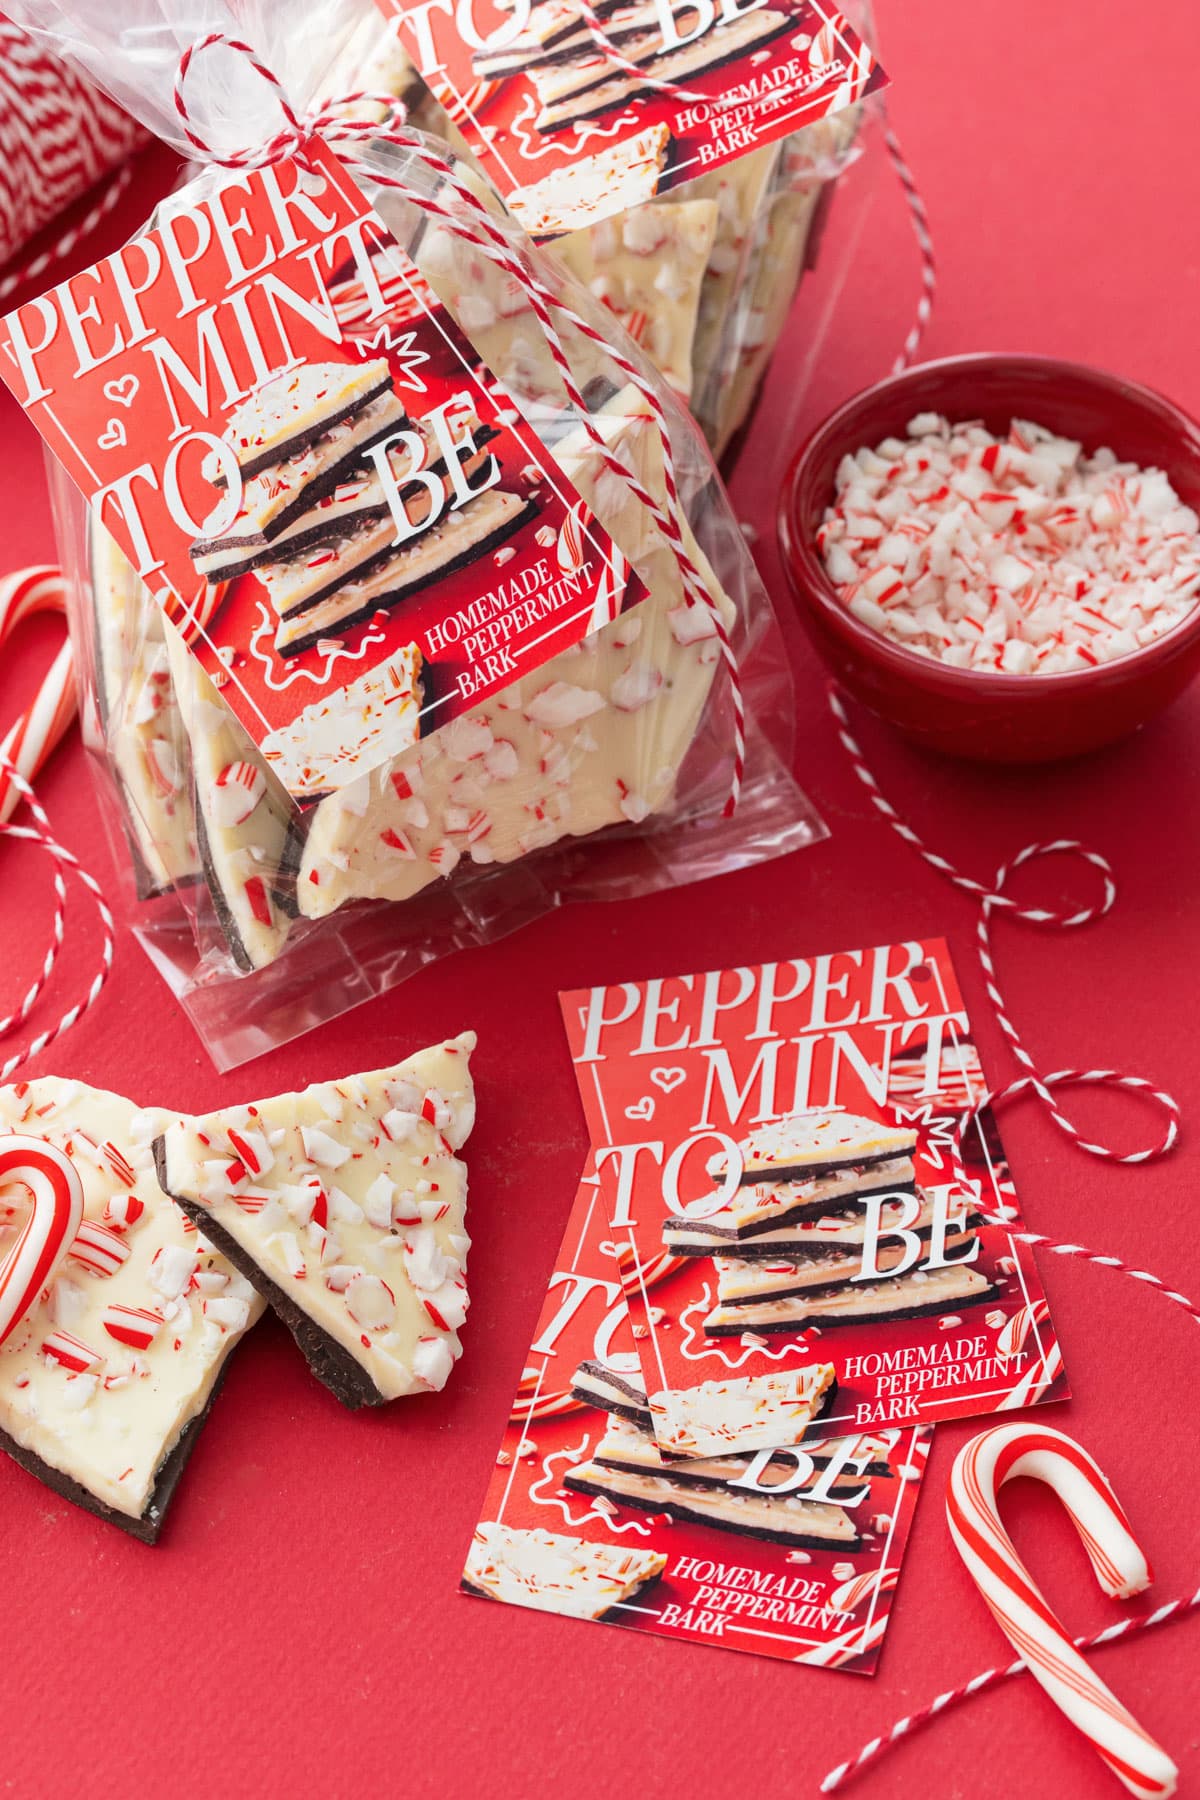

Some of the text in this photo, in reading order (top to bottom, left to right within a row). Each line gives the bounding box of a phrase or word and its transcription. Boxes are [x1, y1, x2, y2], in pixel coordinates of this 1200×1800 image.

[697, 123, 759, 166] BARK
[3, 157, 337, 408] PEPPER
[142, 210, 395, 441] MINT
[91, 390, 502, 577] TO BE
[424, 558, 553, 655] HOMEMADE
[461, 562, 595, 664] PEPPERMINT
[456, 643, 518, 700] BARK
[573, 940, 930, 1064] PEPPER
[690, 1011, 970, 1132] MINT
[595, 1131, 982, 1282] TO BE
[843, 1335, 988, 1380] HOMEMADE
[875, 1352, 1028, 1398] PEPPERMINT
[855, 1394, 921, 1425] BARK
[669, 1556, 826, 1603] HOMEMADE
[689, 1585, 856, 1633] PEPPERMINT
[656, 1603, 733, 1636] BARK
